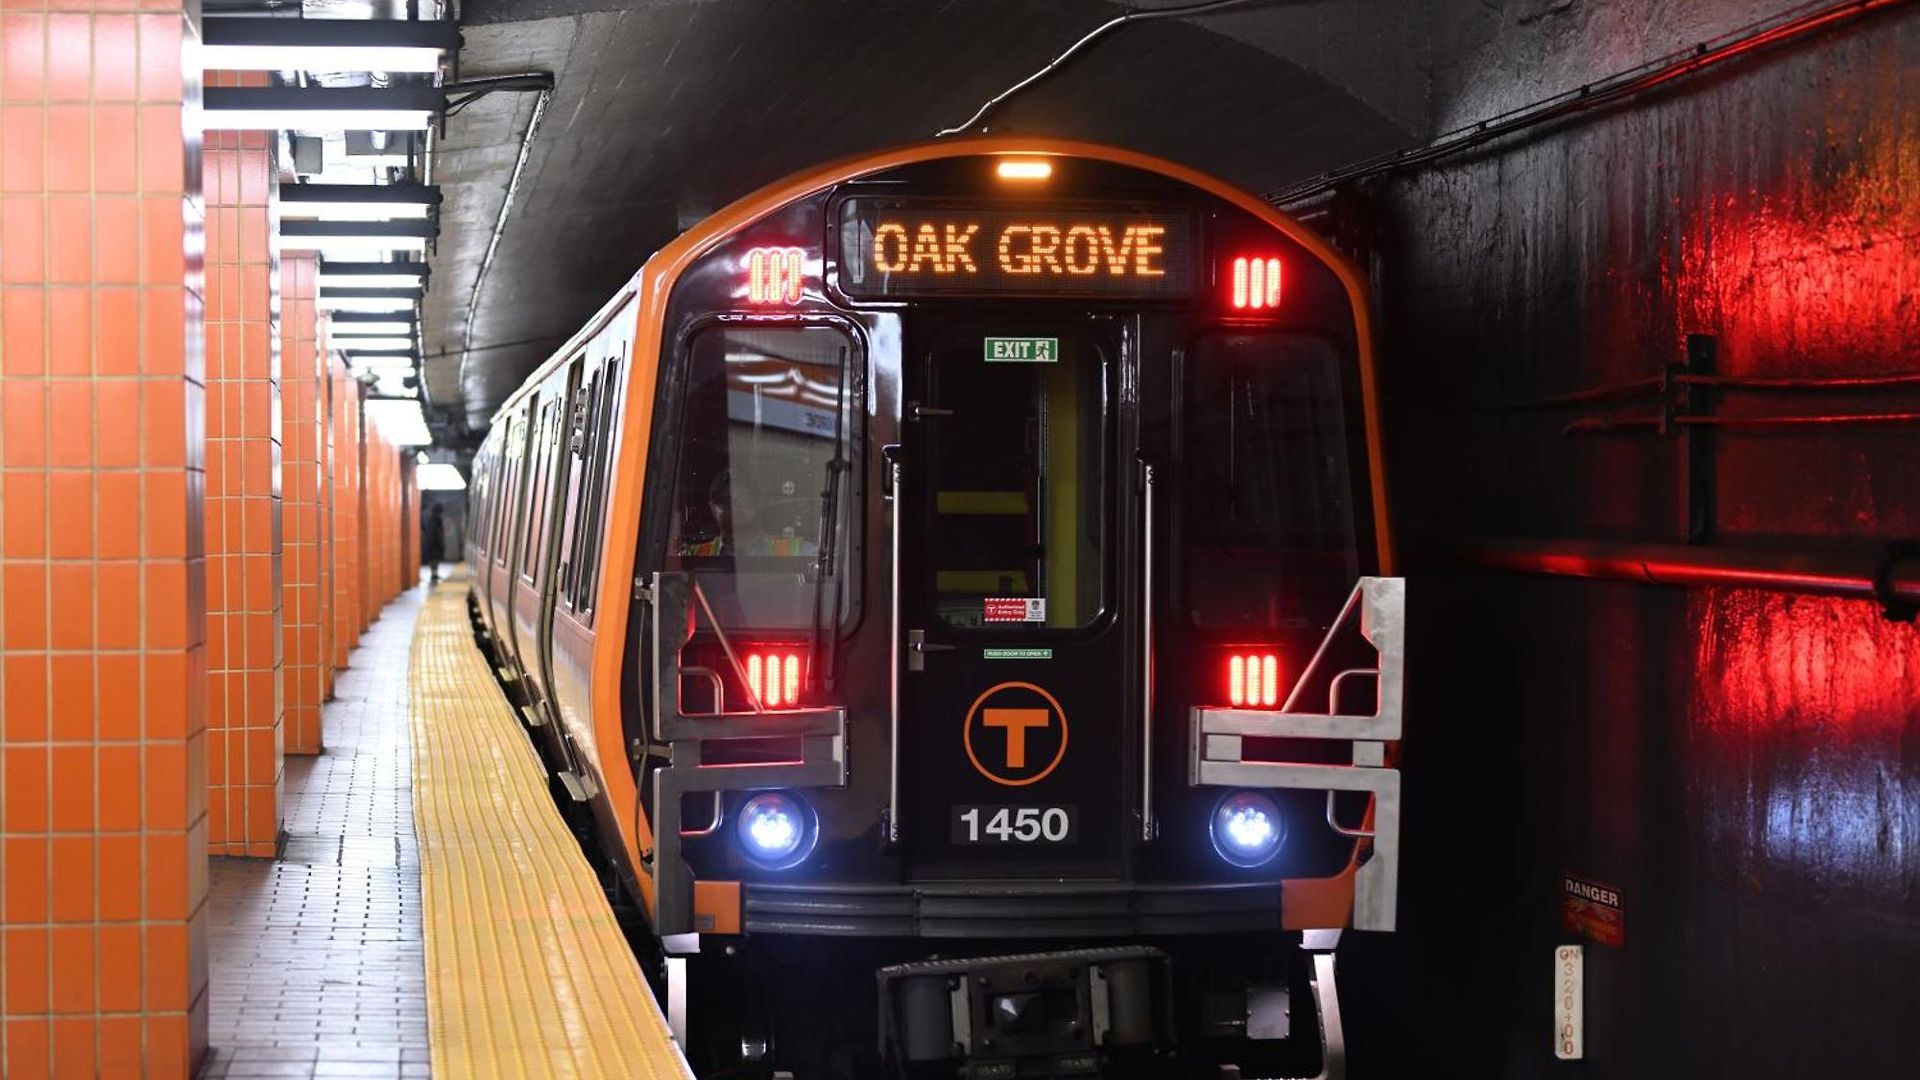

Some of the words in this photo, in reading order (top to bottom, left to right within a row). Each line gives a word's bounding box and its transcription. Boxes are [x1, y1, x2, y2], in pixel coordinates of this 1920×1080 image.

[873, 223, 979, 273] OAK
[998, 225, 1166, 275] GROVE
[993, 341, 1031, 359] EXIT
[983, 708, 1049, 768] T
[960, 807, 1069, 842] 1450
[1565, 879, 1619, 907] DANGER
